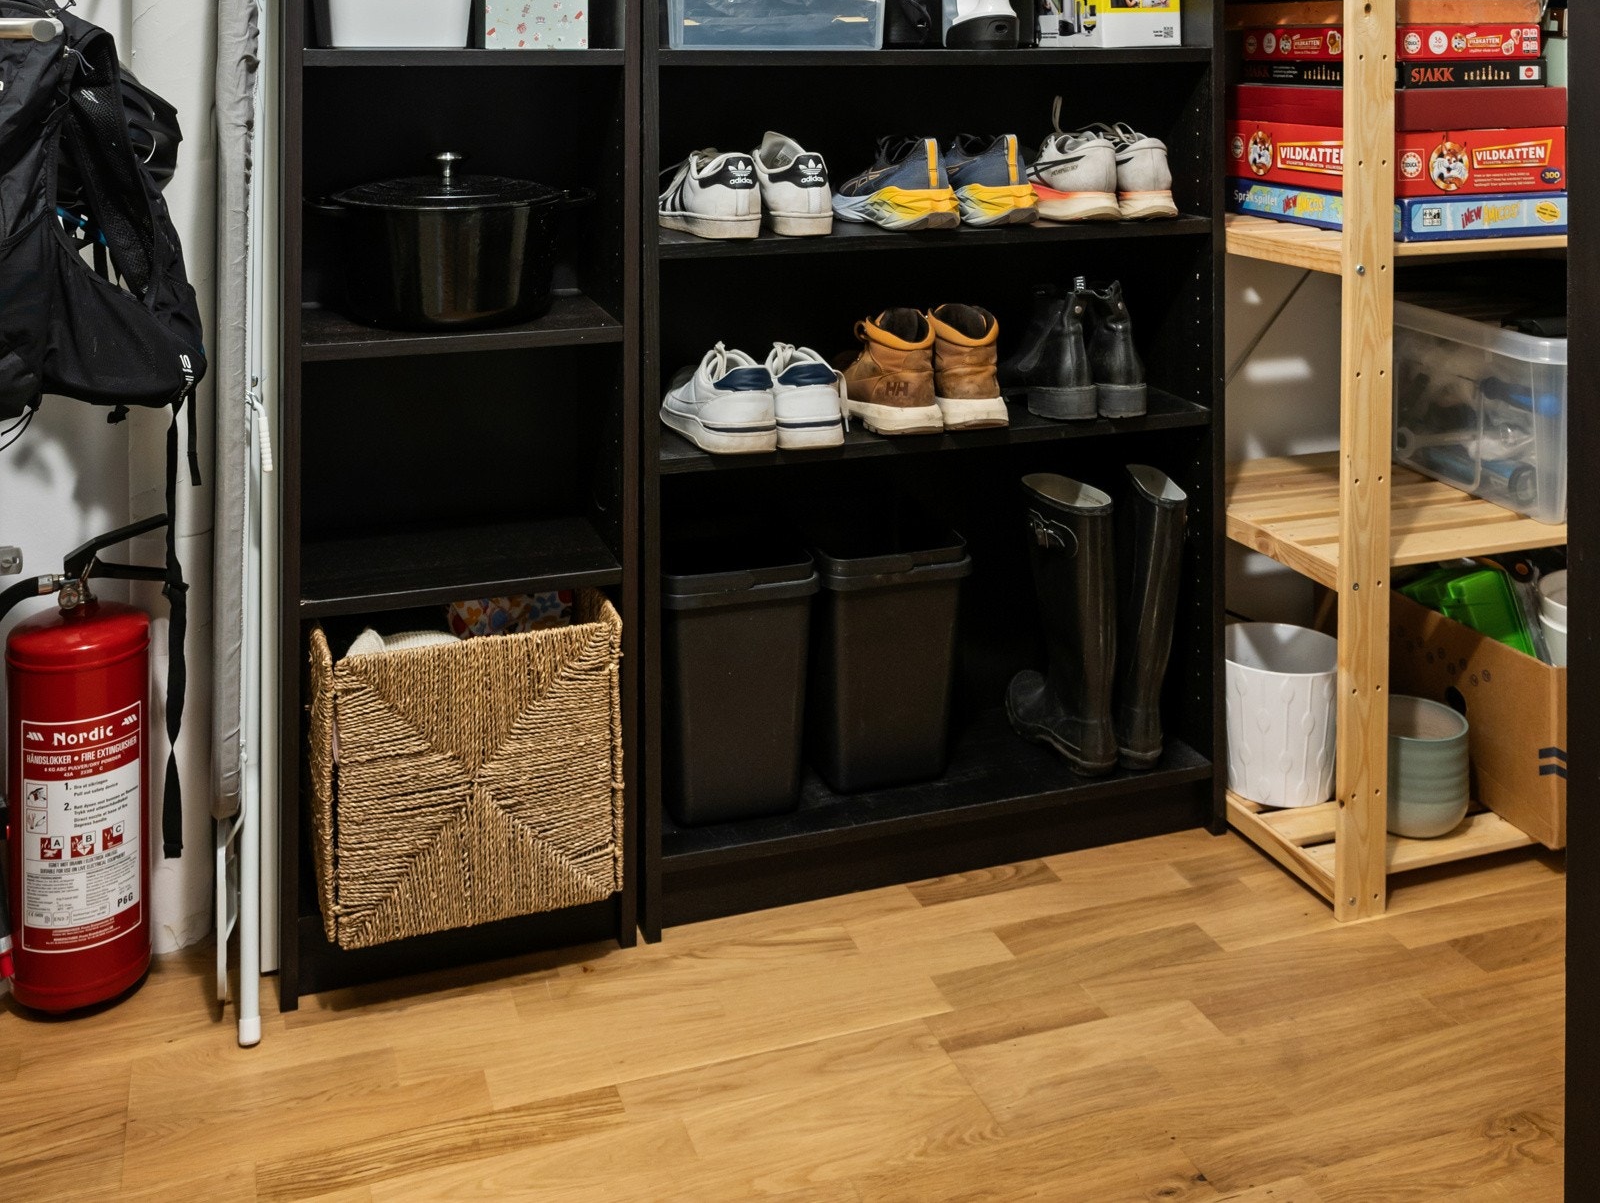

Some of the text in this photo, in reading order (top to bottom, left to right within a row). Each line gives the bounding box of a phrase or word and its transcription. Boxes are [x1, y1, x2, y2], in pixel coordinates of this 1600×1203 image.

[1411, 67, 1455, 85] SJAKK
[1475, 146, 1545, 162] VILDKATTEN
[729, 175, 753, 185] adidas
[801, 175, 824, 183] adidas
[1234, 189, 1277, 206] Språkspillet
[179, 354, 191, 368] 10
[885, 382, 909, 396] HH
[53, 725, 114, 746] Nordic
[26, 735, 137, 765] HÅNDSLOKKER FIRE EXTINGUISHER
[64, 782, 72, 791] 1.
[64, 802, 72, 811] 2.
[115, 825, 121, 833] C
[54, 839, 61, 847] A
[85, 835, 92, 843] B
